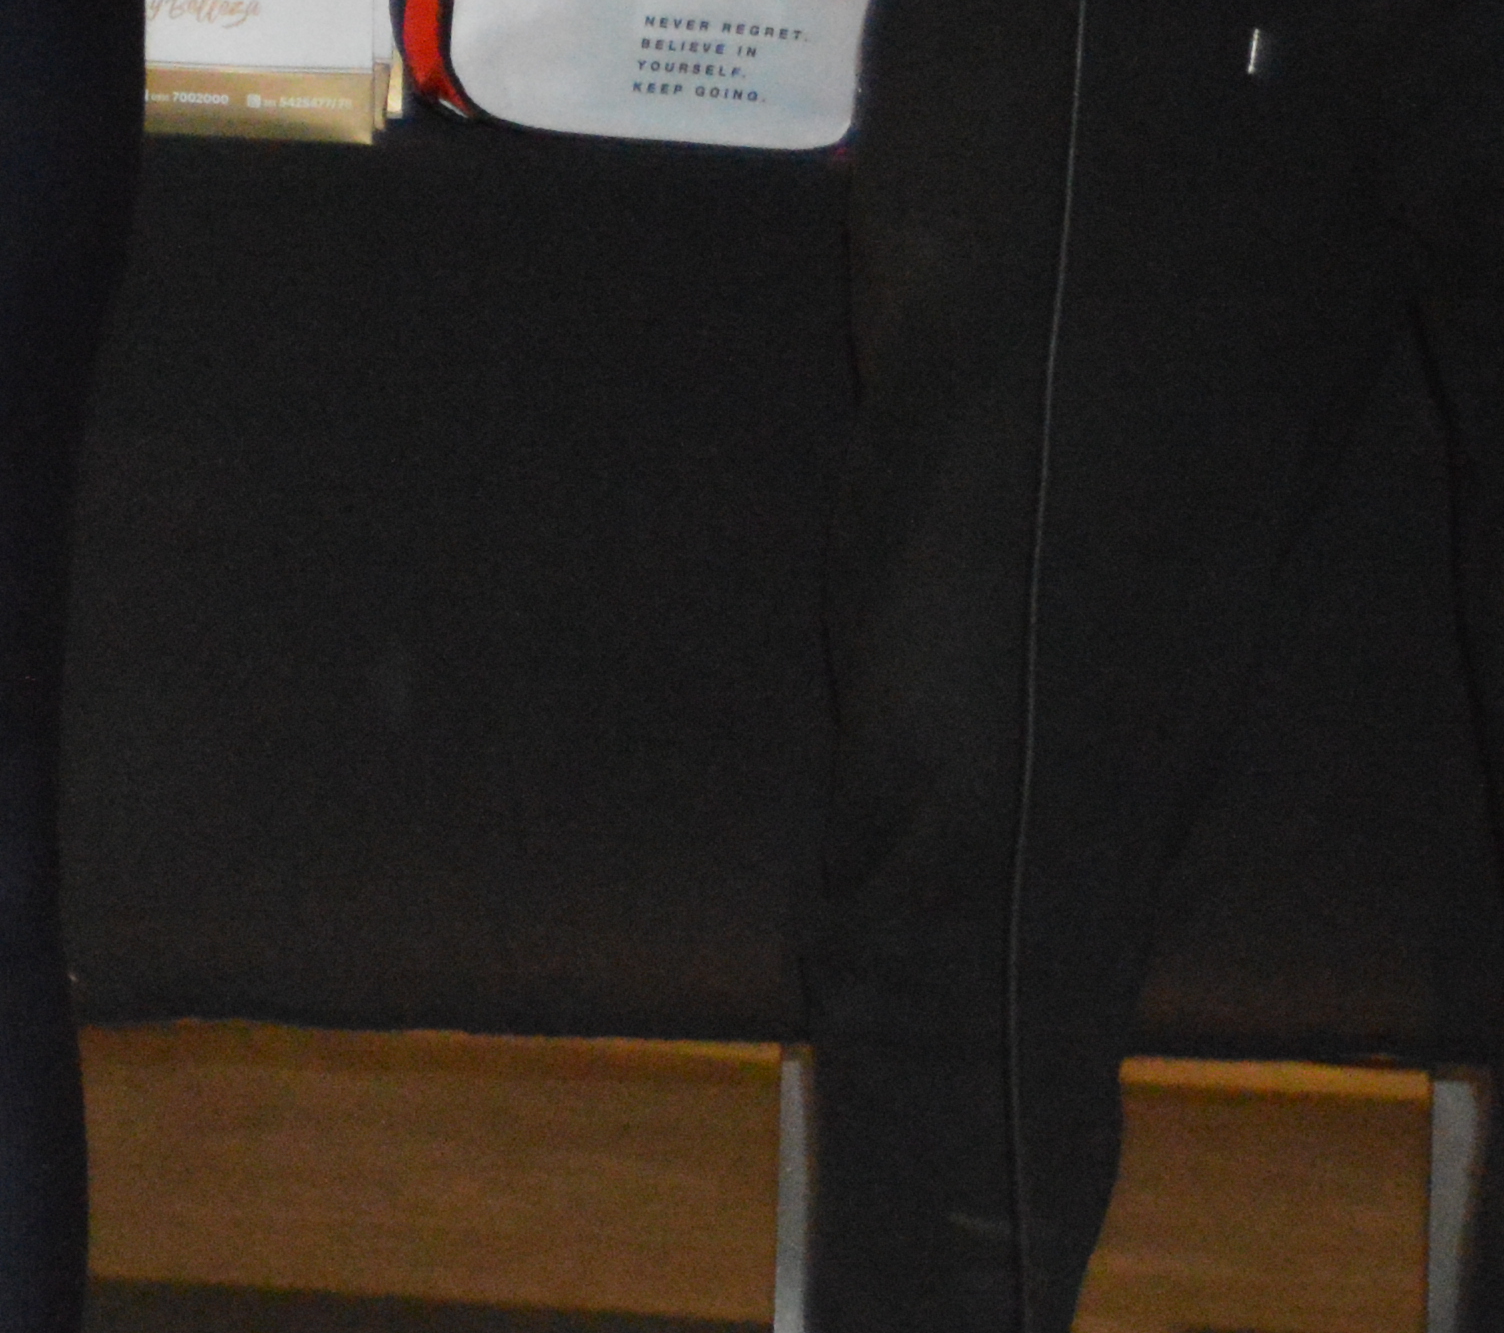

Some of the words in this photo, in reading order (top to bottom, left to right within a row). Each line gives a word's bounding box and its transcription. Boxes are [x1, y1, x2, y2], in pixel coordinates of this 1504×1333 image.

[644, 15, 711, 32] NEVER
[721, 20, 812, 44] REGRET.
[640, 37, 727, 56] BELIEVE
[736, 45, 758, 58] IN
[636, 59, 748, 81] YOURSELF.
[632, 80, 684, 95] KEEP
[693, 85, 768, 105] GOING.
